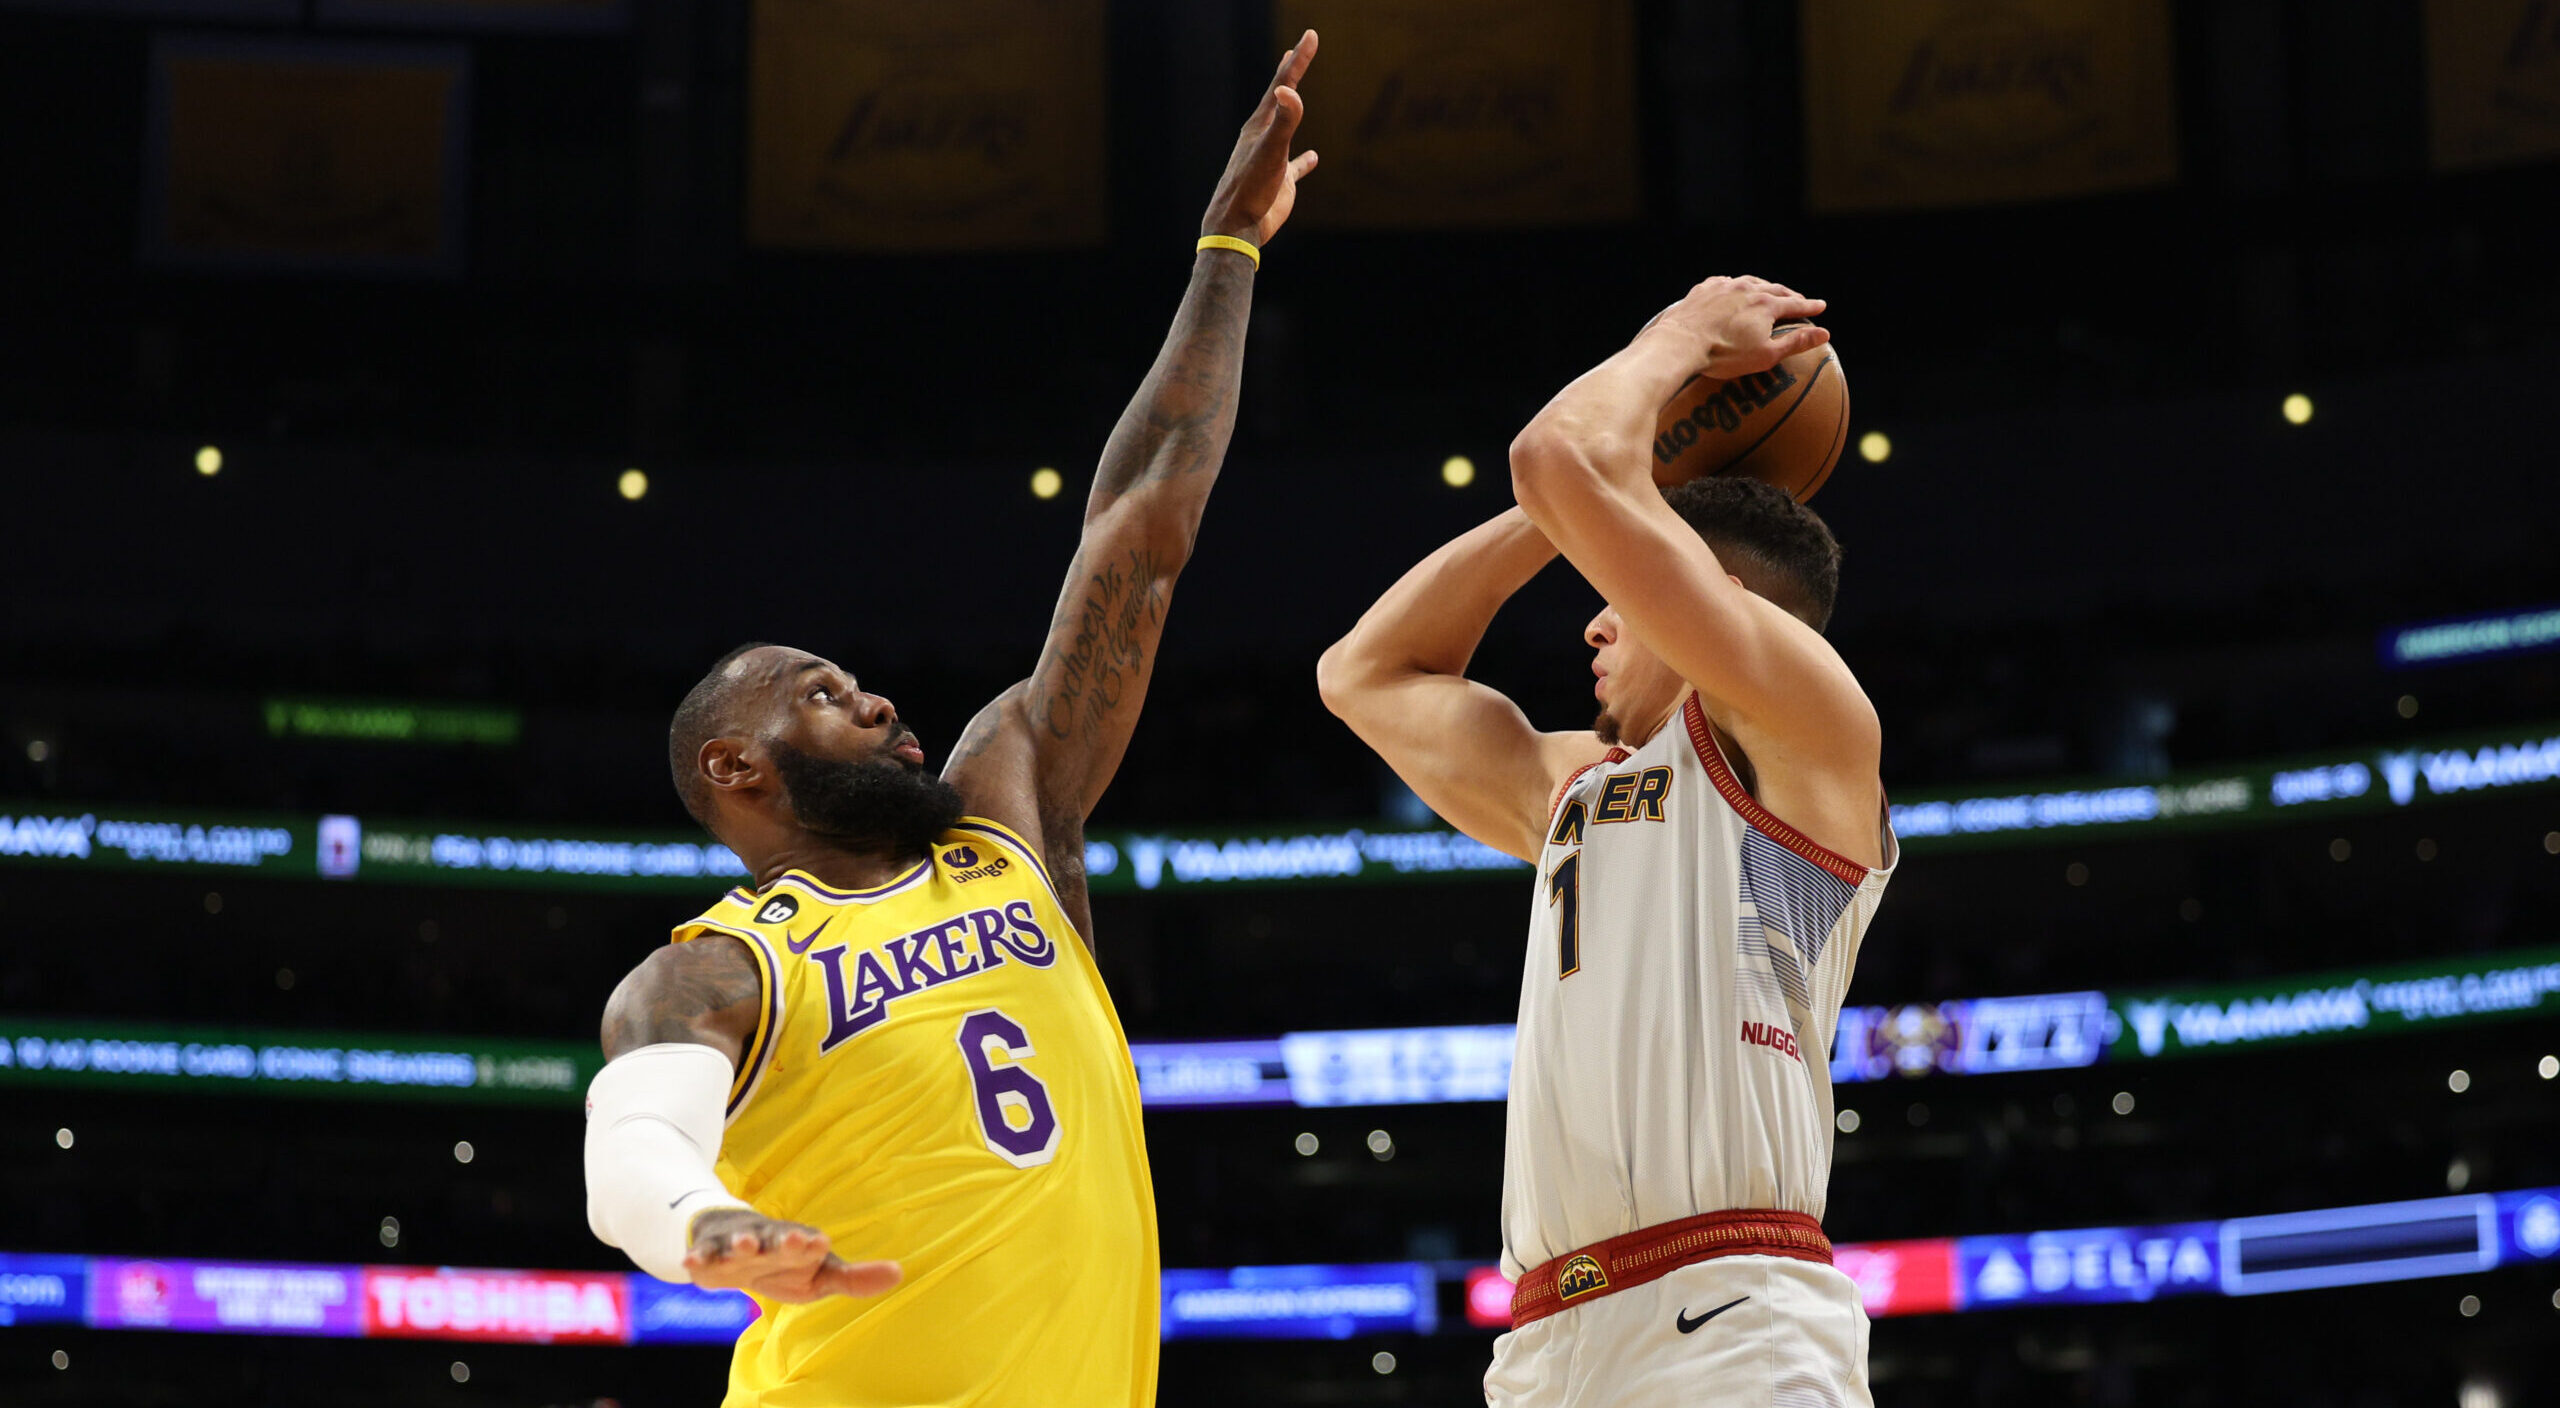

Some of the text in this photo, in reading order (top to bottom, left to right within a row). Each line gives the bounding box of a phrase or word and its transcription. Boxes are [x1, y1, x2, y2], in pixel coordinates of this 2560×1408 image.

[1653, 362, 1796, 464] Wilson
[950, 855, 1010, 885] bibigo
[760, 899, 794, 924] 6
[1549, 848, 1581, 981] 1
[807, 899, 1057, 1058] LAKERS
[955, 1007, 1064, 1170] 6
[372, 1275, 620, 1336] TOSHIBA
[2030, 1236, 2214, 1294] DELTA
